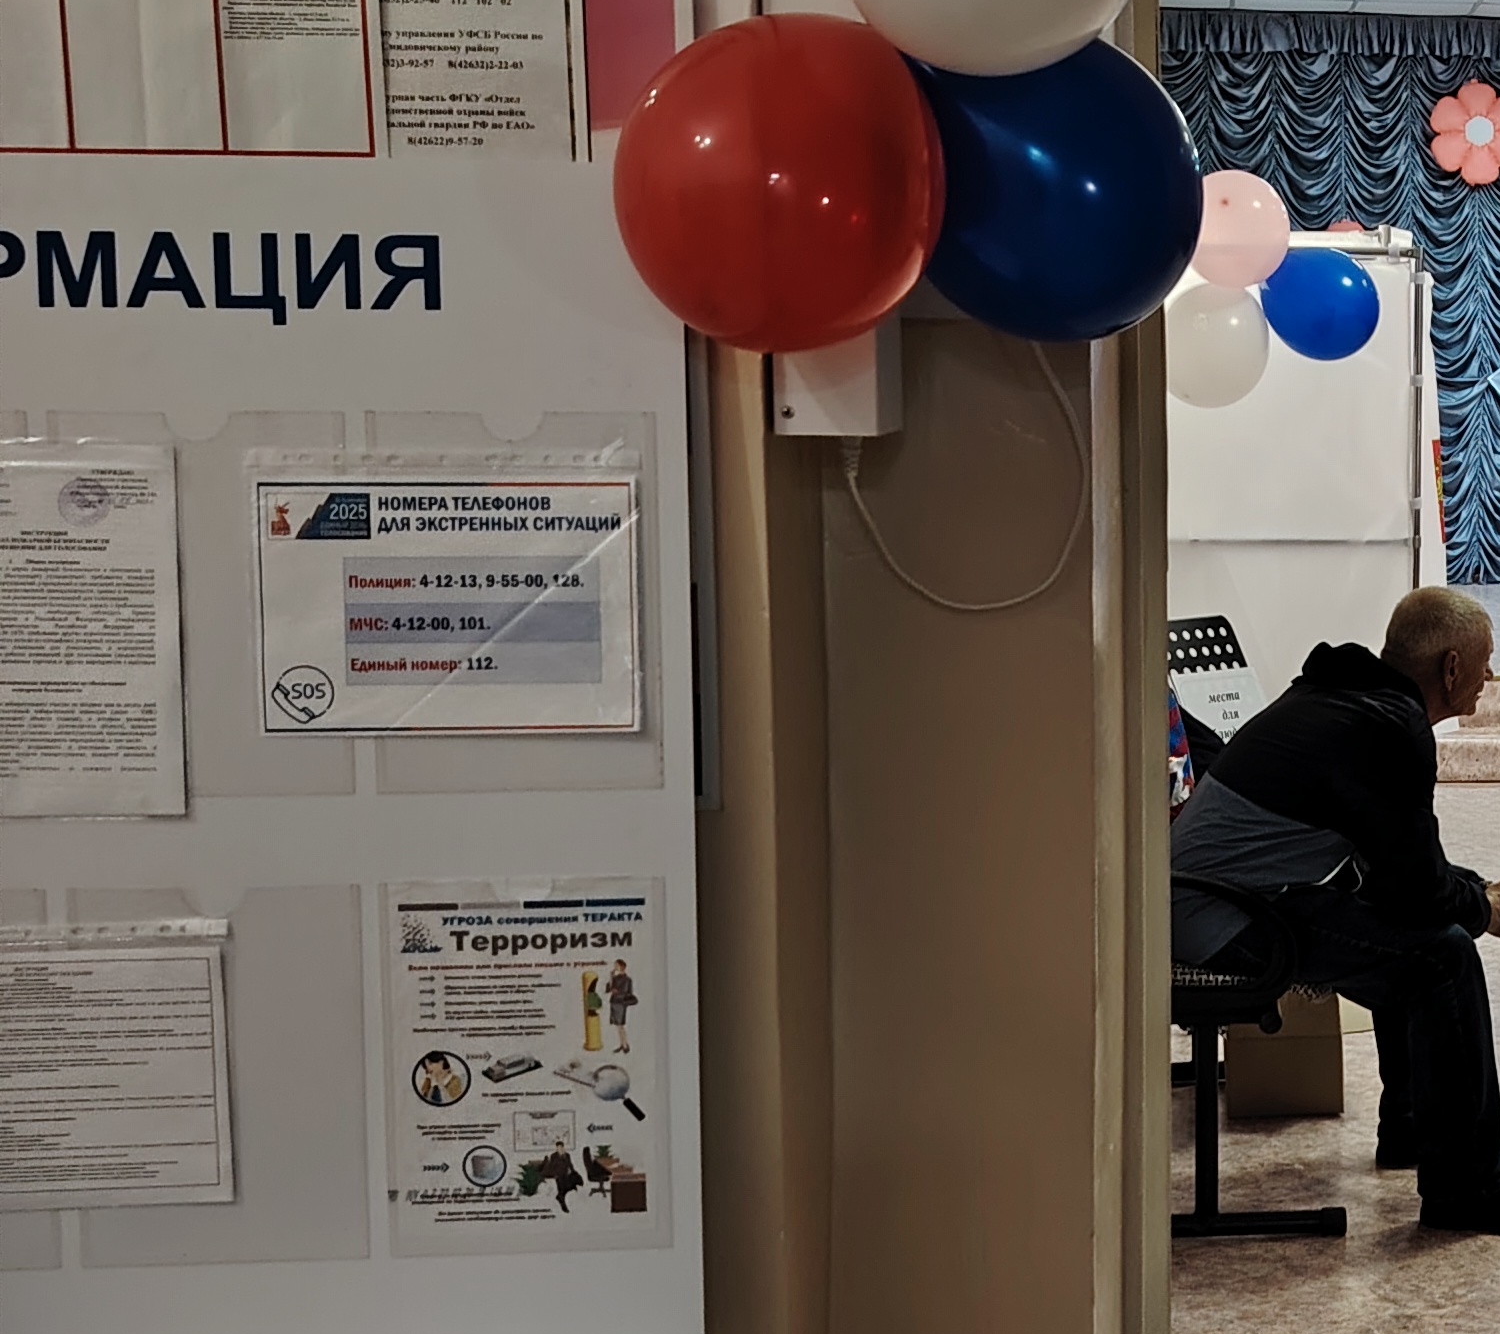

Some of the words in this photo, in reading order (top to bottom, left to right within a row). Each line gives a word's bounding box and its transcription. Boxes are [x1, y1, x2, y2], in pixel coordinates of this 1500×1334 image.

[395, 30, 455, 41] управления
[494, 30, 529, 40] России
[465, 43, 500, 54] району
[418, 94, 446, 102] часть
[449, 93, 482, 103] ФГКУ
[378, 496, 448, 511] НОМЕРА
[452, 496, 551, 511] ТЕЛЕФОНОВ
[329, 504, 367, 520] 2025
[377, 517, 411, 534] ДЛЯ
[415, 517, 529, 532] ЭКСТРЕННЫХ
[533, 513, 621, 533] СИТУАЦИЙ
[348, 575, 416, 590] Полиция:
[419, 575, 483, 590] 4-12-13,
[486, 574, 548, 590] 9-55-00,
[350, 617, 389, 631] МЧС:
[392, 617, 455, 632] 4-12-00,
[459, 617, 491, 630] 101.
[350, 657, 407, 672] Единый
[411, 660, 462, 673] номер:
[466, 657, 498, 670] 112.
[291, 683, 327, 699] SOS
[1208, 691, 1240, 704] места
[1222, 709, 1240, 720] для
[442, 914, 492, 927] УГРОЗА
[497, 915, 579, 926] совершения
[583, 912, 643, 923] ТЕРАКТА
[450, 929, 633, 956] Терроризм
